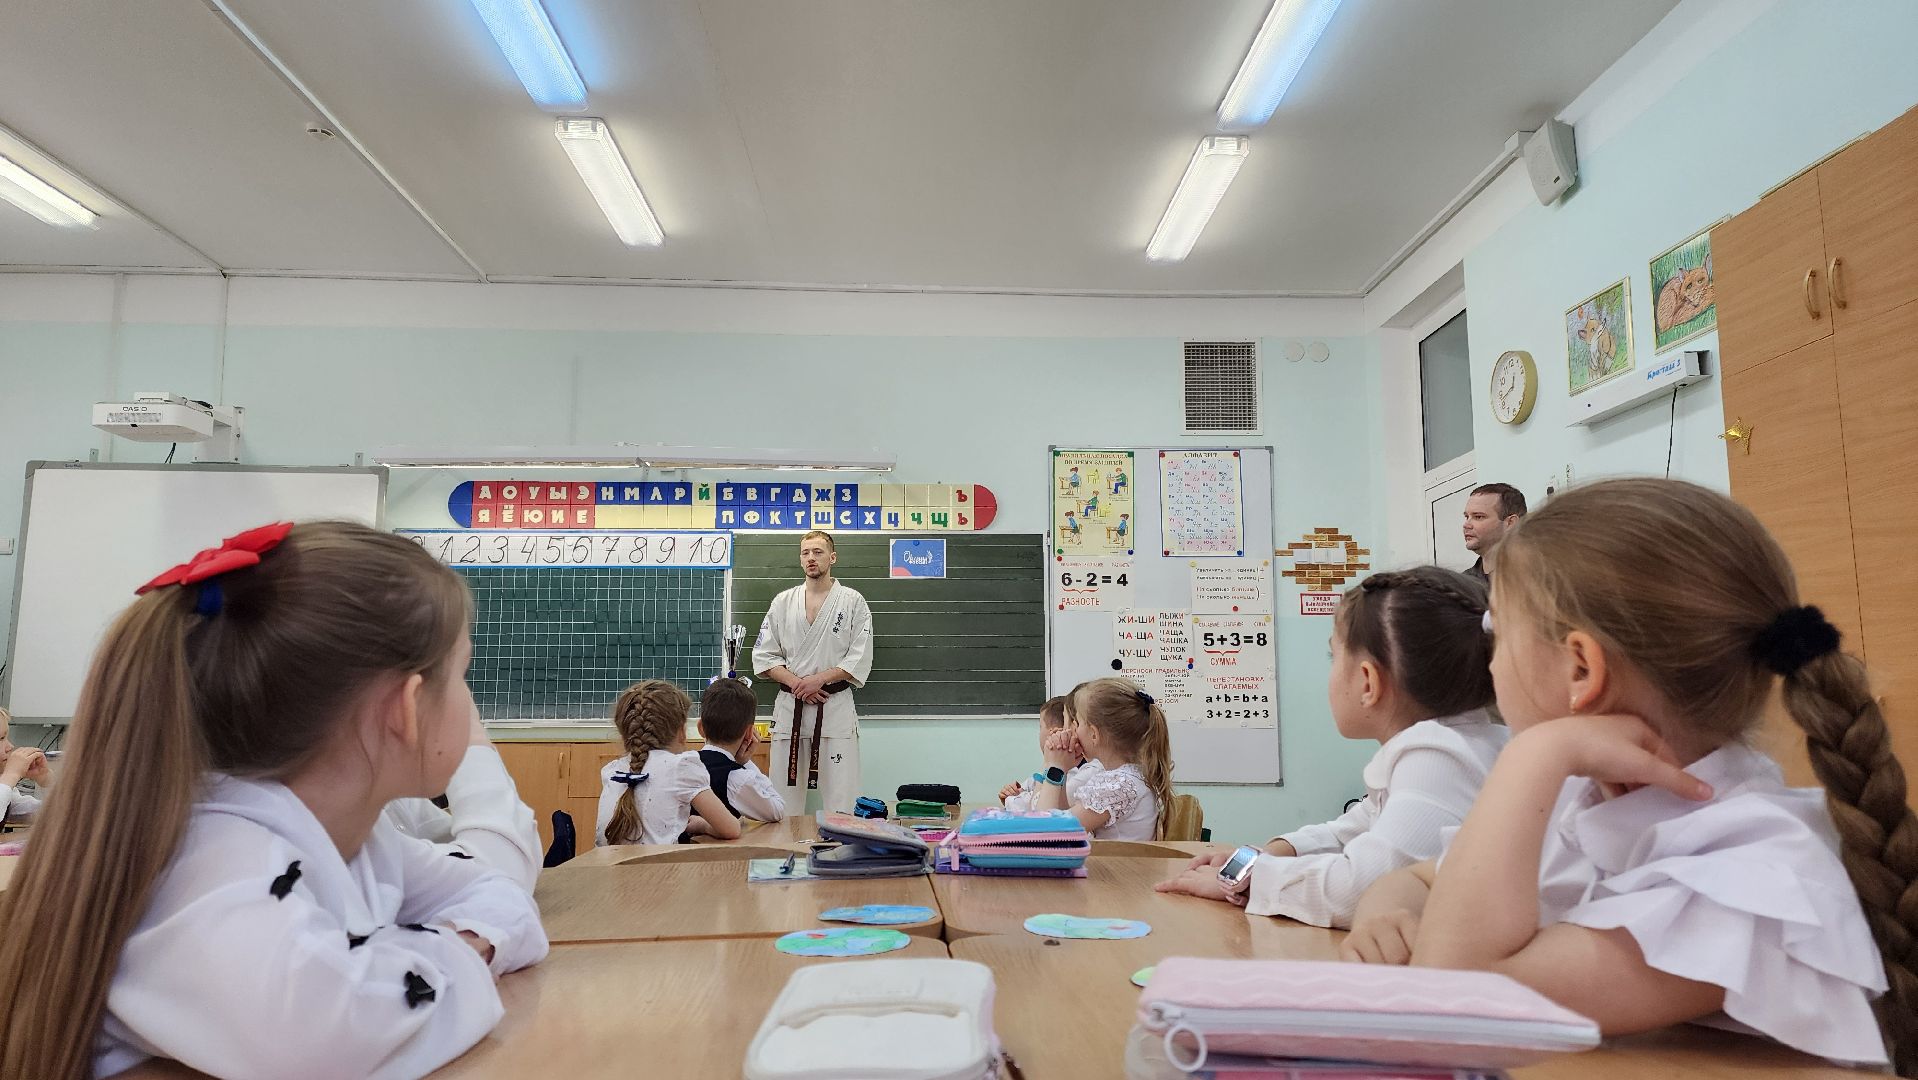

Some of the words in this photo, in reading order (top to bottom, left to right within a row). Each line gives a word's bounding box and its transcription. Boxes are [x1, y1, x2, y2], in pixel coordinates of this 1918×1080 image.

[479, 485, 492, 500] А
[502, 486, 518, 500] О
[528, 486, 540, 500] У
[550, 486, 568, 500] Ы
[577, 486, 590, 500] Э
[601, 486, 614, 501] Н
[624, 487, 640, 500] М
[650, 486, 662, 500] Л
[674, 487, 686, 500] Р
[698, 483, 710, 500] Й
[722, 486, 735, 501] Б
[746, 487, 758, 501] В
[770, 488, 782, 501] Г
[792, 488, 807, 502] Д
[814, 488, 832, 502] Ж
[842, 488, 852, 502] З
[956, 490, 968, 502] Ъ
[478, 509, 490, 522] Я
[502, 504, 514, 522] Ё
[524, 510, 544, 524] Ю
[551, 510, 564, 524] И
[576, 510, 588, 524] Е
[722, 510, 734, 524] П
[744, 510, 760, 524] Ф
[770, 510, 782, 525] К
[794, 510, 806, 524] Т
[814, 511, 832, 524] Ш
[840, 510, 852, 525] С
[864, 511, 876, 525] Х
[888, 512, 900, 528] Ц
[910, 512, 922, 525] Ч
[931, 512, 948, 528] Щ
[957, 512, 968, 526] Ь
[440, 536, 453, 560] 1
[460, 536, 481, 564] 2
[488, 536, 508, 563] 3
[520, 536, 536, 564] 4
[542, 536, 564, 564] 5
[572, 536, 592, 564] 6
[602, 536, 620, 564] 7
[628, 536, 648, 564] 8
[656, 536, 676, 564] 9
